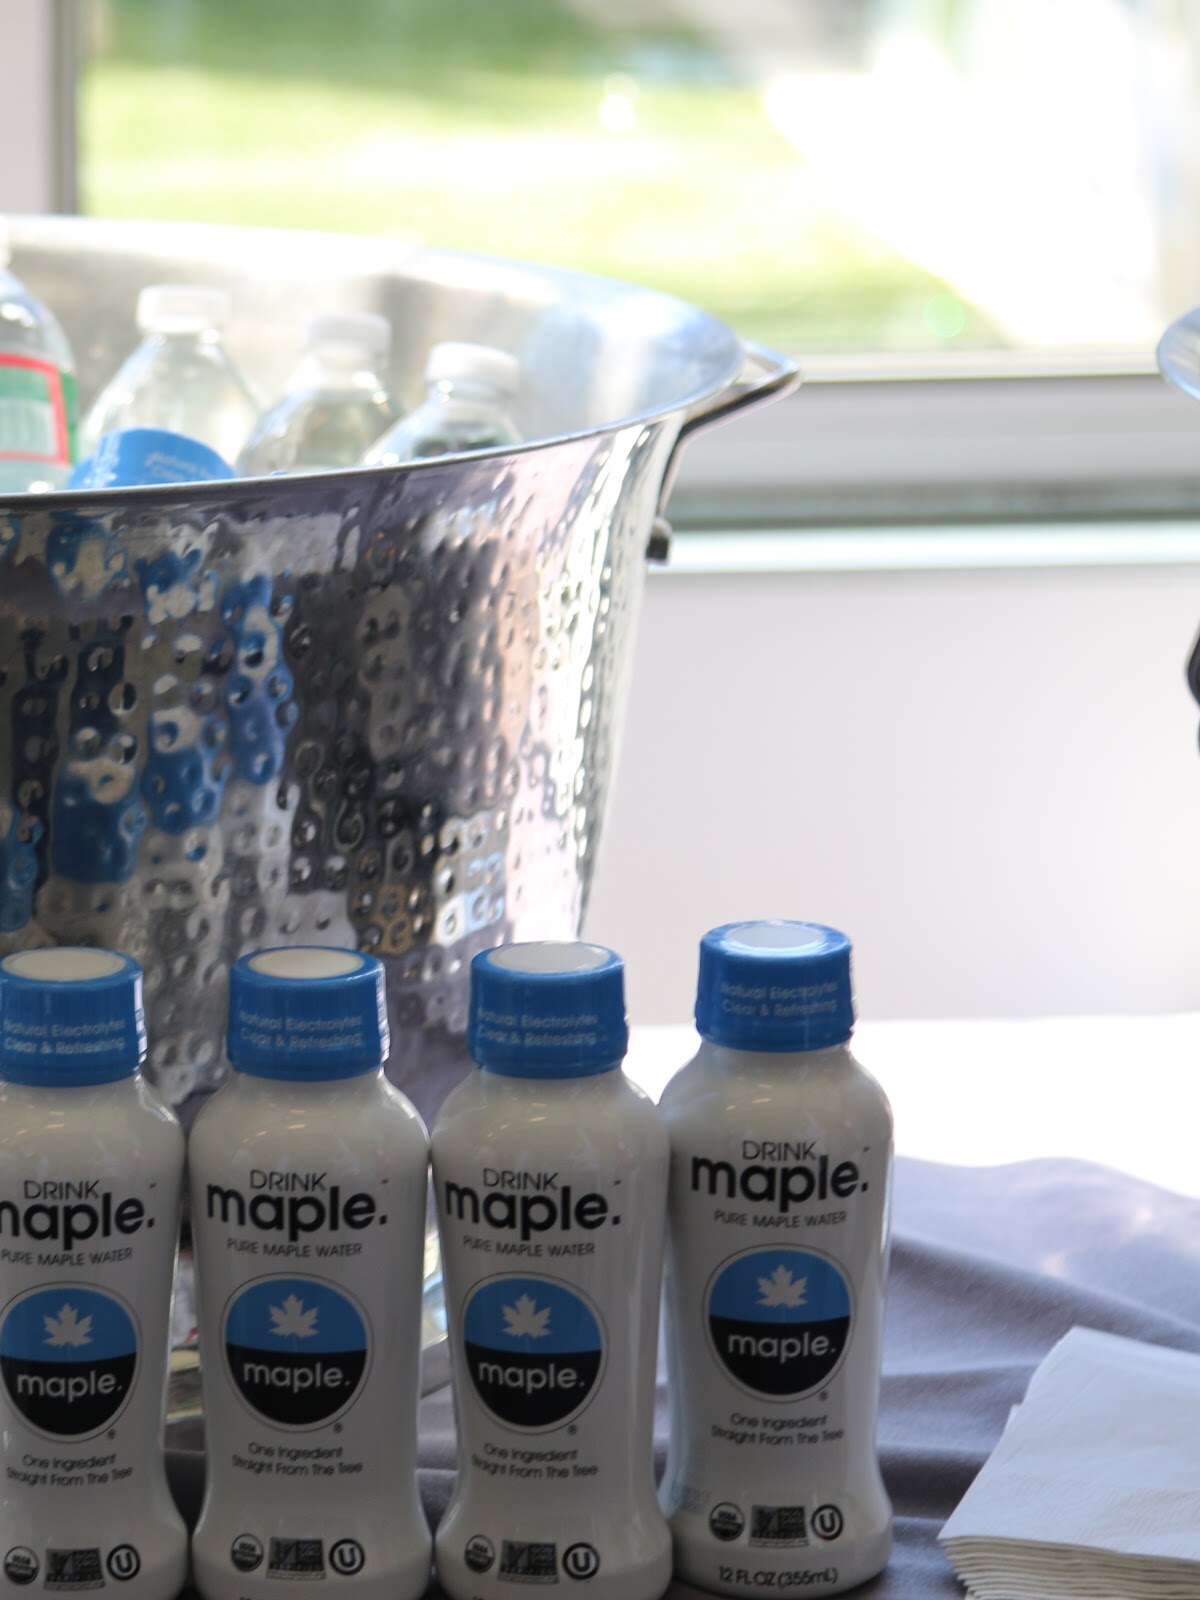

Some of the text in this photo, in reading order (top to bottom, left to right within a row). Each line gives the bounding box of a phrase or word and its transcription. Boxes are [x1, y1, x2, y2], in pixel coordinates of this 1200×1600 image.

[742, 1139, 817, 1162] DRINK
[23, 1179, 100, 1201] DRINK
[249, 1169, 328, 1192] DRINK
[483, 1167, 560, 1191] DRINK
[714, 1209, 848, 1229] PURE MAPLE WATER
[227, 1237, 363, 1258] PURE MAPLE WATER
[463, 1235, 596, 1257] PURE MAPLE WATER
[1, 1248, 133, 1267] PURE MAPLE WATER
[727, 1331, 836, 1364] maple.
[16, 1369, 123, 1404] maple.
[243, 1361, 351, 1394] maple.
[478, 1361, 585, 1394] maple.
[730, 1412, 828, 1431] One Ingredient
[759, 1432, 793, 1445] From
[797, 1431, 819, 1444] The
[822, 1429, 845, 1441] Tree
[248, 1441, 343, 1461] One Ingredient
[484, 1442, 578, 1464] One Ingredient
[22, 1453, 117, 1472] One Ingredient
[275, 1462, 309, 1476] From
[312, 1462, 335, 1476] The
[338, 1462, 363, 1474] Tree
[509, 1465, 543, 1478] From
[546, 1465, 569, 1478] The
[573, 1464, 598, 1477] Tree
[50, 1473, 84, 1487] From
[87, 1472, 109, 1484] The
[111, 1466, 133, 1481] Tree
[720, 1565, 733, 1584] 12
[736, 1570, 751, 1585] FL
[753, 1570, 777, 1588] OZ
